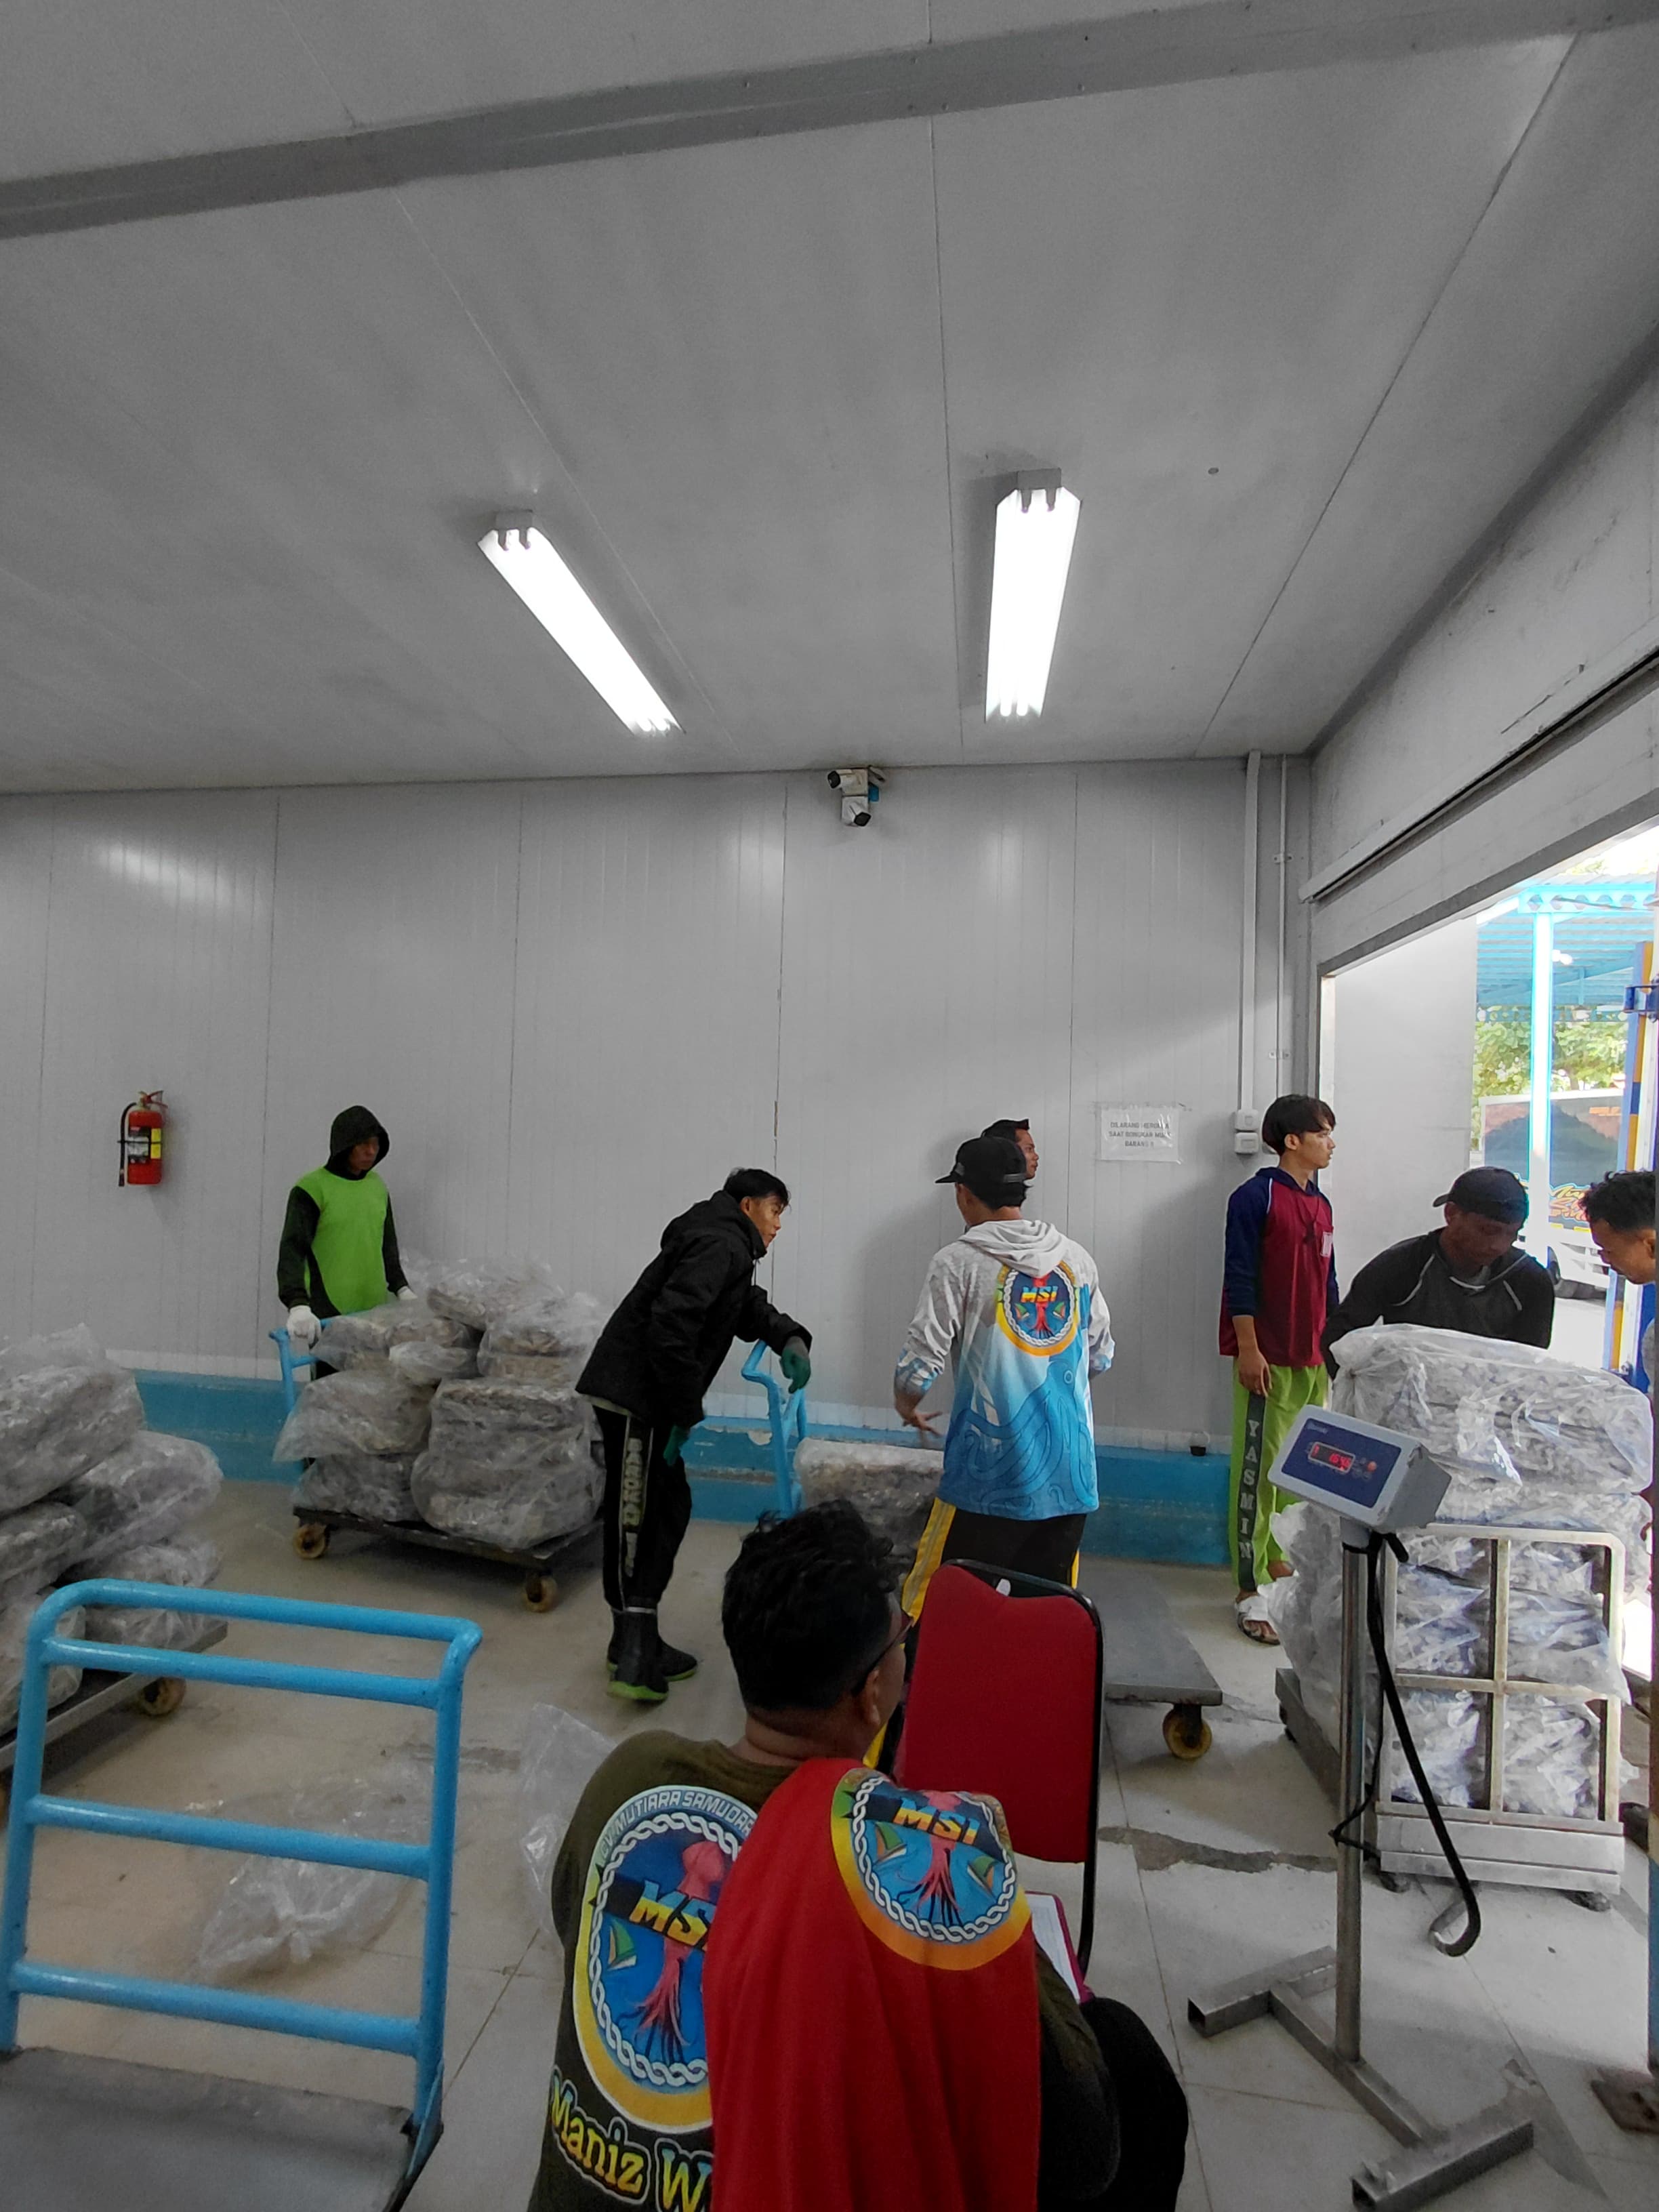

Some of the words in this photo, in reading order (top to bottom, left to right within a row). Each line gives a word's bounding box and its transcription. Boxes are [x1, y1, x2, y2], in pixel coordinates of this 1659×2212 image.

[1020, 1285, 1059, 1303] MSI
[1239, 1419, 1260, 1559] YASMIN
[616, 1791, 682, 1832] MUTIARA
[893, 1797, 981, 1845] MSI
[628, 1880, 716, 1952] MS
